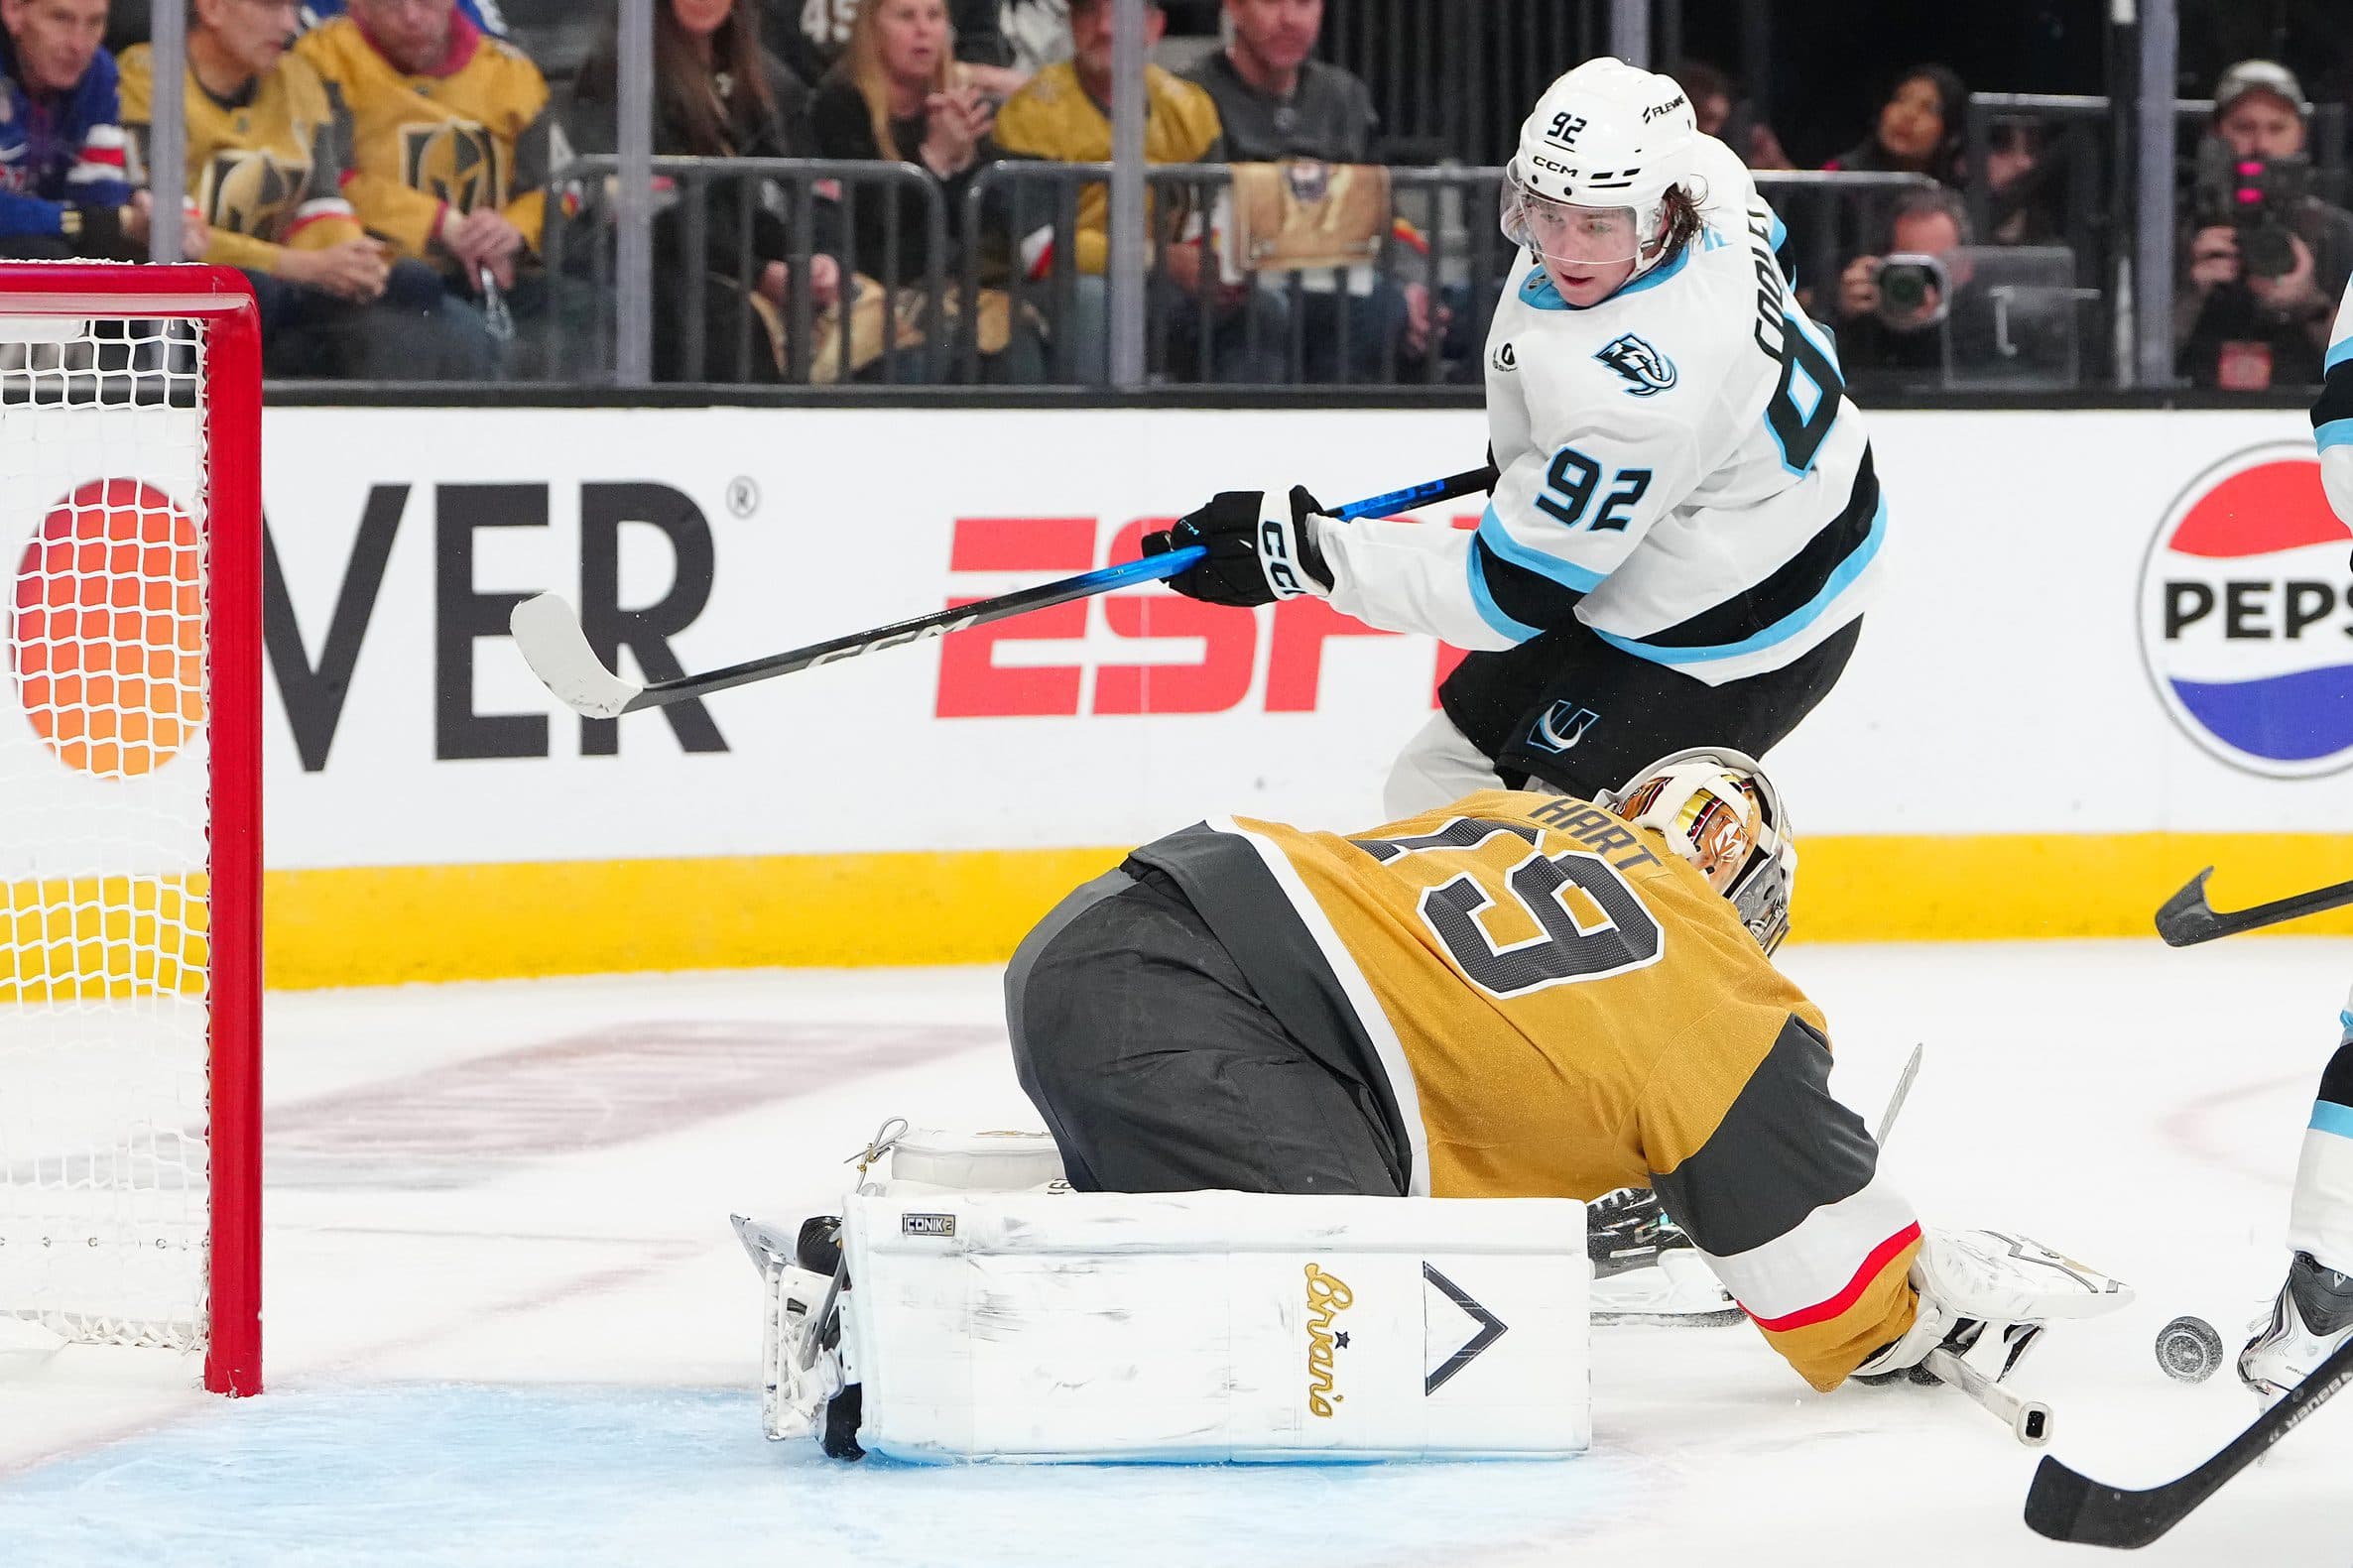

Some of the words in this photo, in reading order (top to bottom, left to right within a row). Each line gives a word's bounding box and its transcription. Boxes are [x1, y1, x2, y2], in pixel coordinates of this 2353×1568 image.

[1547, 111, 1588, 145] 92
[1533, 155, 1579, 178] CCM
[1533, 445, 1653, 533] 92
[1261, 520, 1307, 595] CC
[933, 516, 1488, 719] ESP
[2165, 581, 2353, 640] PEP
[1528, 797, 1663, 872] HART
[1304, 1263, 1353, 1418] Brian's
